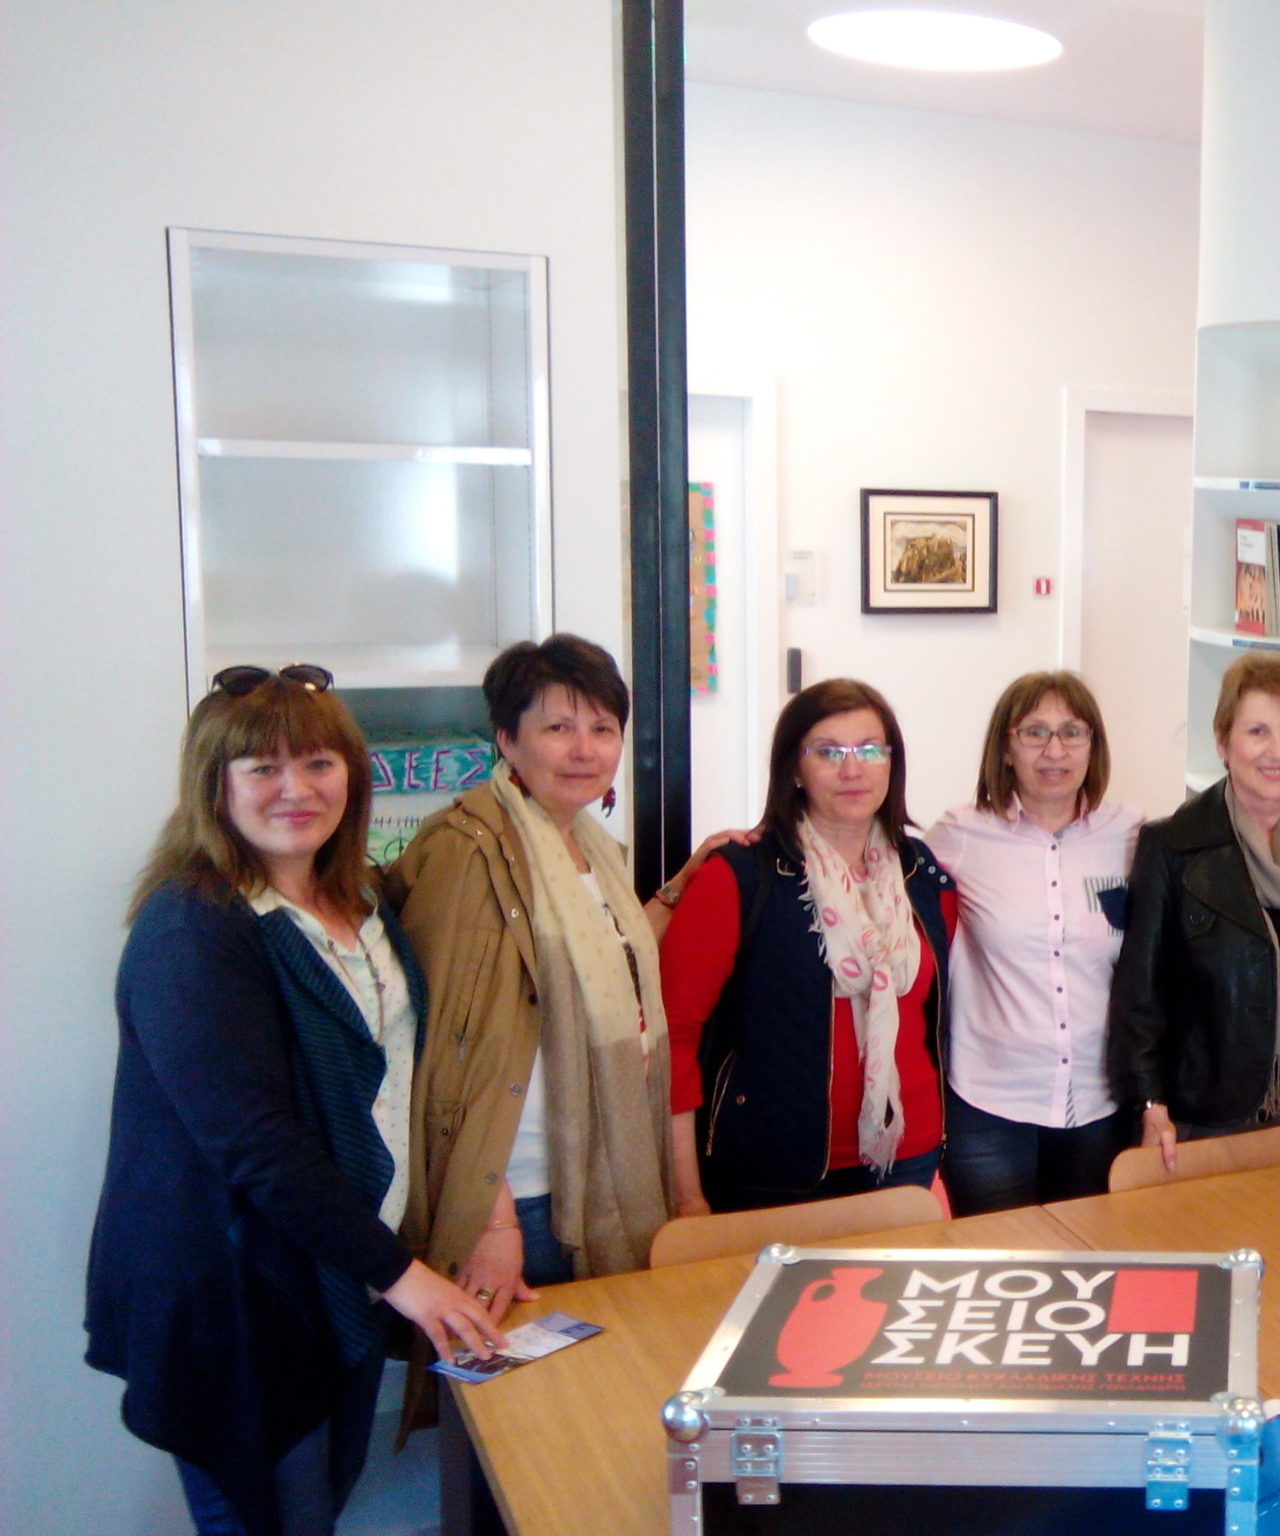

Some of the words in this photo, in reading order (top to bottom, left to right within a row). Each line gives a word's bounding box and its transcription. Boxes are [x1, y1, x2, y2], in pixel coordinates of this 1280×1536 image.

[902, 1268, 1116, 1299] ΜΟΥ
[884, 1299, 1106, 1332] ΣΕΙΟ
[870, 1331, 1191, 1367] ΣΚΕΥΗ
[1105, 1372, 1186, 1383] ΤΕΧΝΗΣ
